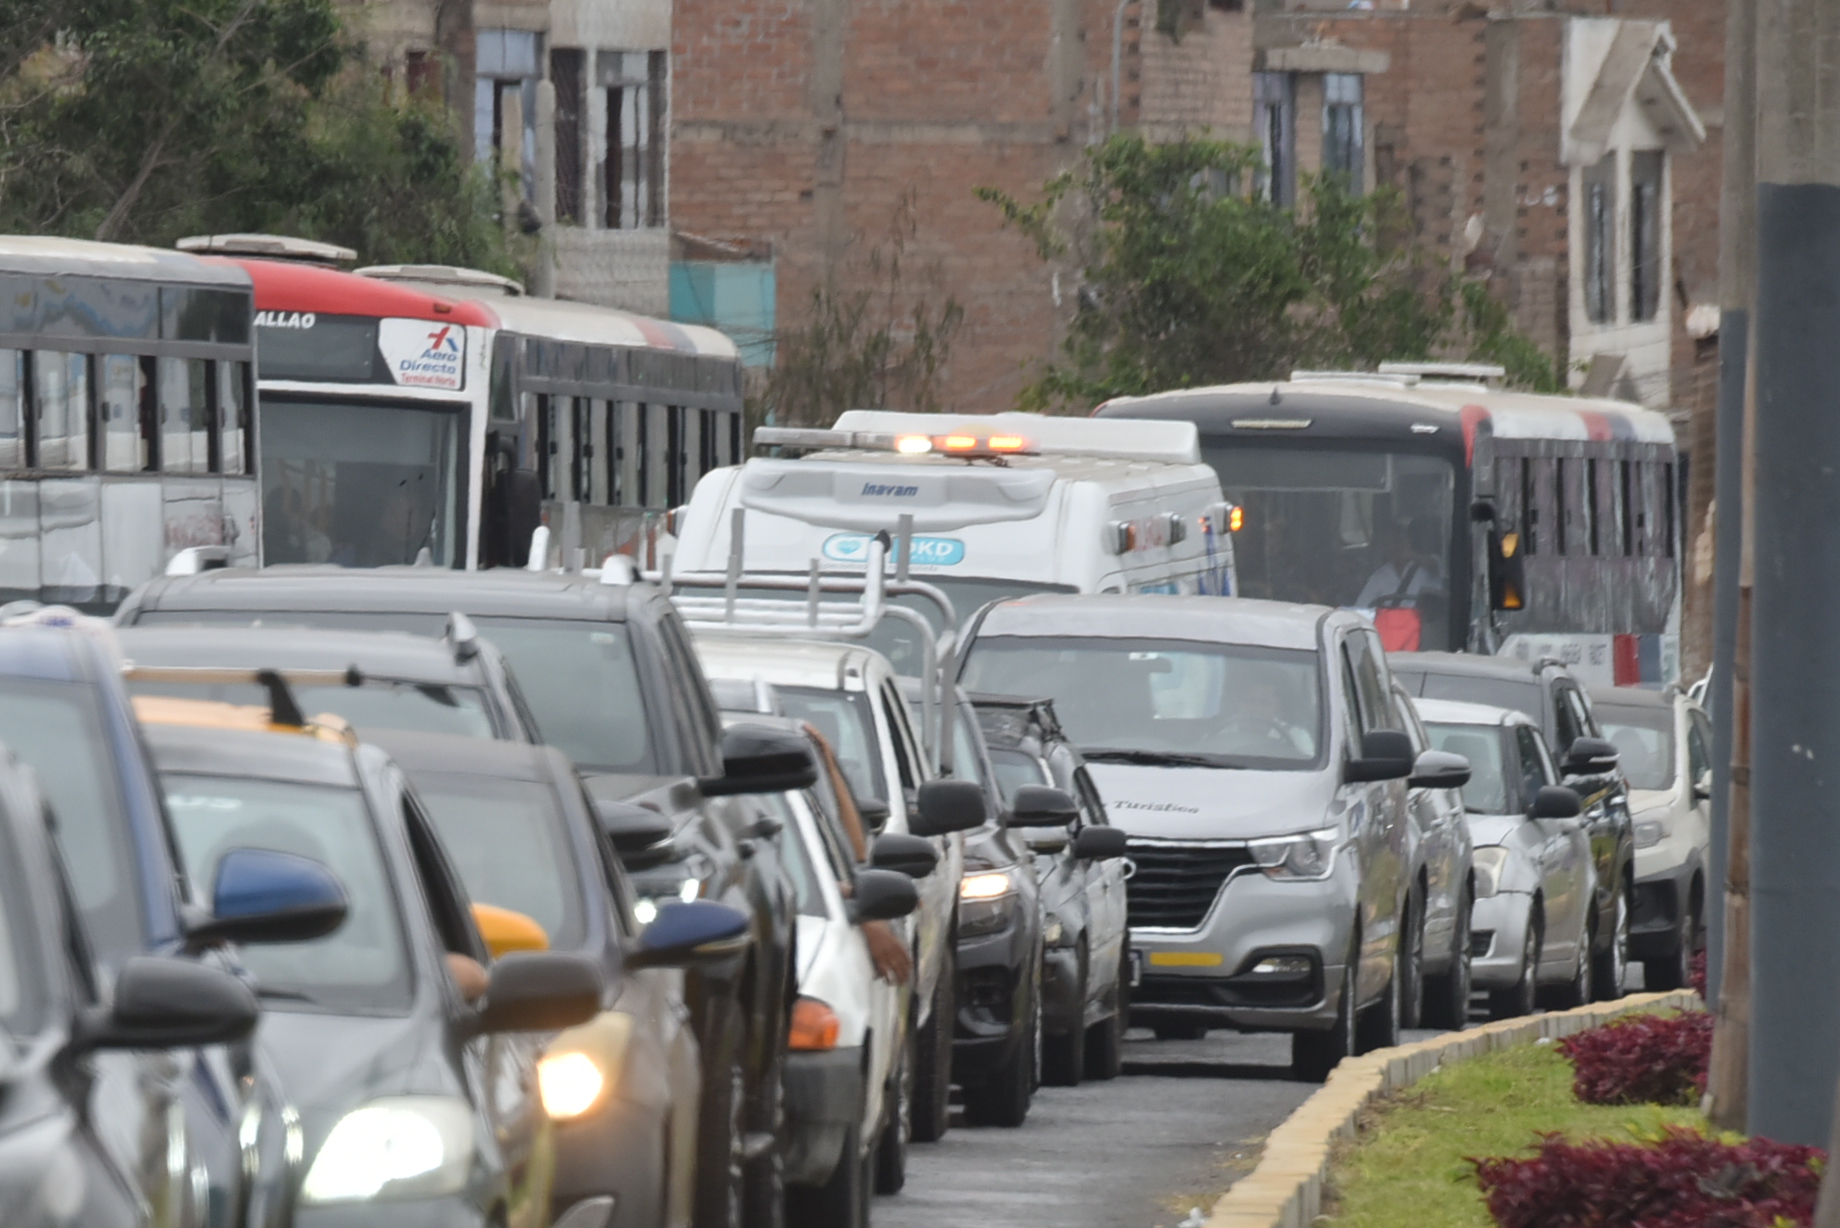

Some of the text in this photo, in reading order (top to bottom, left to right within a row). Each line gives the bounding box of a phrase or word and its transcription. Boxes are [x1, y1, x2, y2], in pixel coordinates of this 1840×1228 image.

[421, 348, 457, 362] Aero
[399, 359, 457, 374] Directo
[862, 482, 919, 496] Inavam
